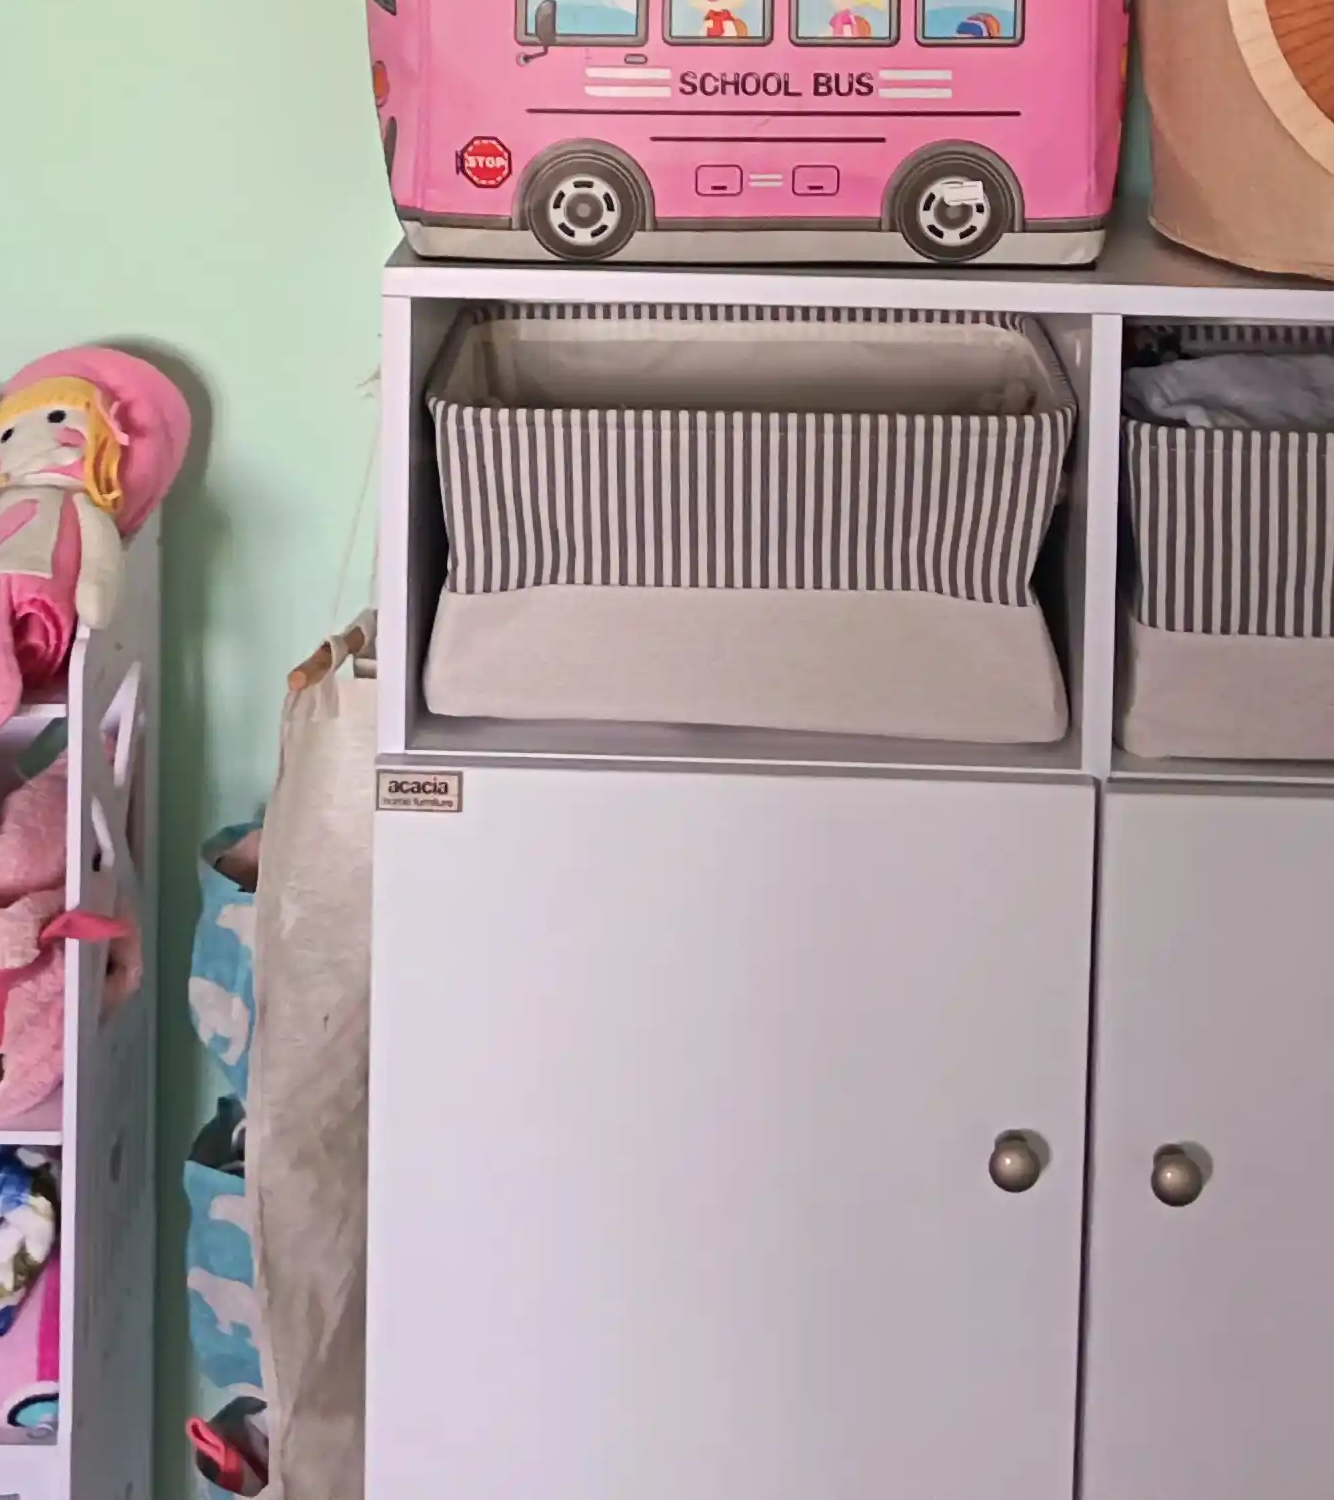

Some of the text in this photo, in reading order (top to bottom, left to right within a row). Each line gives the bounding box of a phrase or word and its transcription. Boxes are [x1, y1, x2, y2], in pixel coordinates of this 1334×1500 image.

[679, 70, 874, 97] SCHOOL BUS
[467, 155, 506, 169] STOP
[388, 776, 449, 795] acacia
